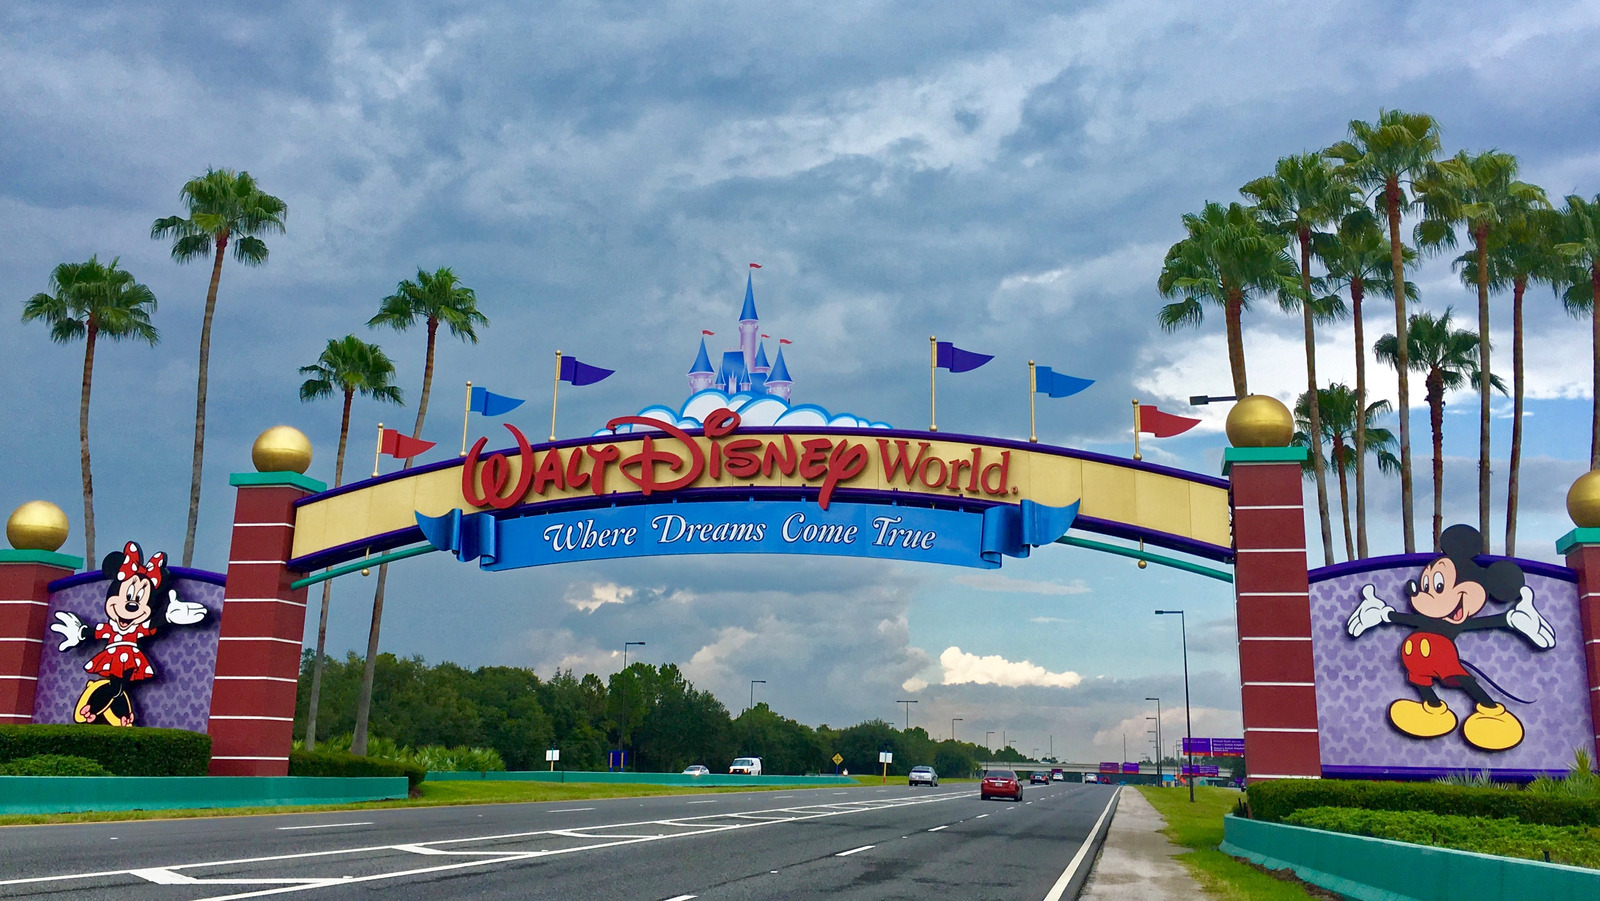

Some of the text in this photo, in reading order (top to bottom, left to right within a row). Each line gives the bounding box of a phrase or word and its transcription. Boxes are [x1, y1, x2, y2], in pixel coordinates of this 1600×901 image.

[543, 512, 937, 552] Where Dreams Come True
